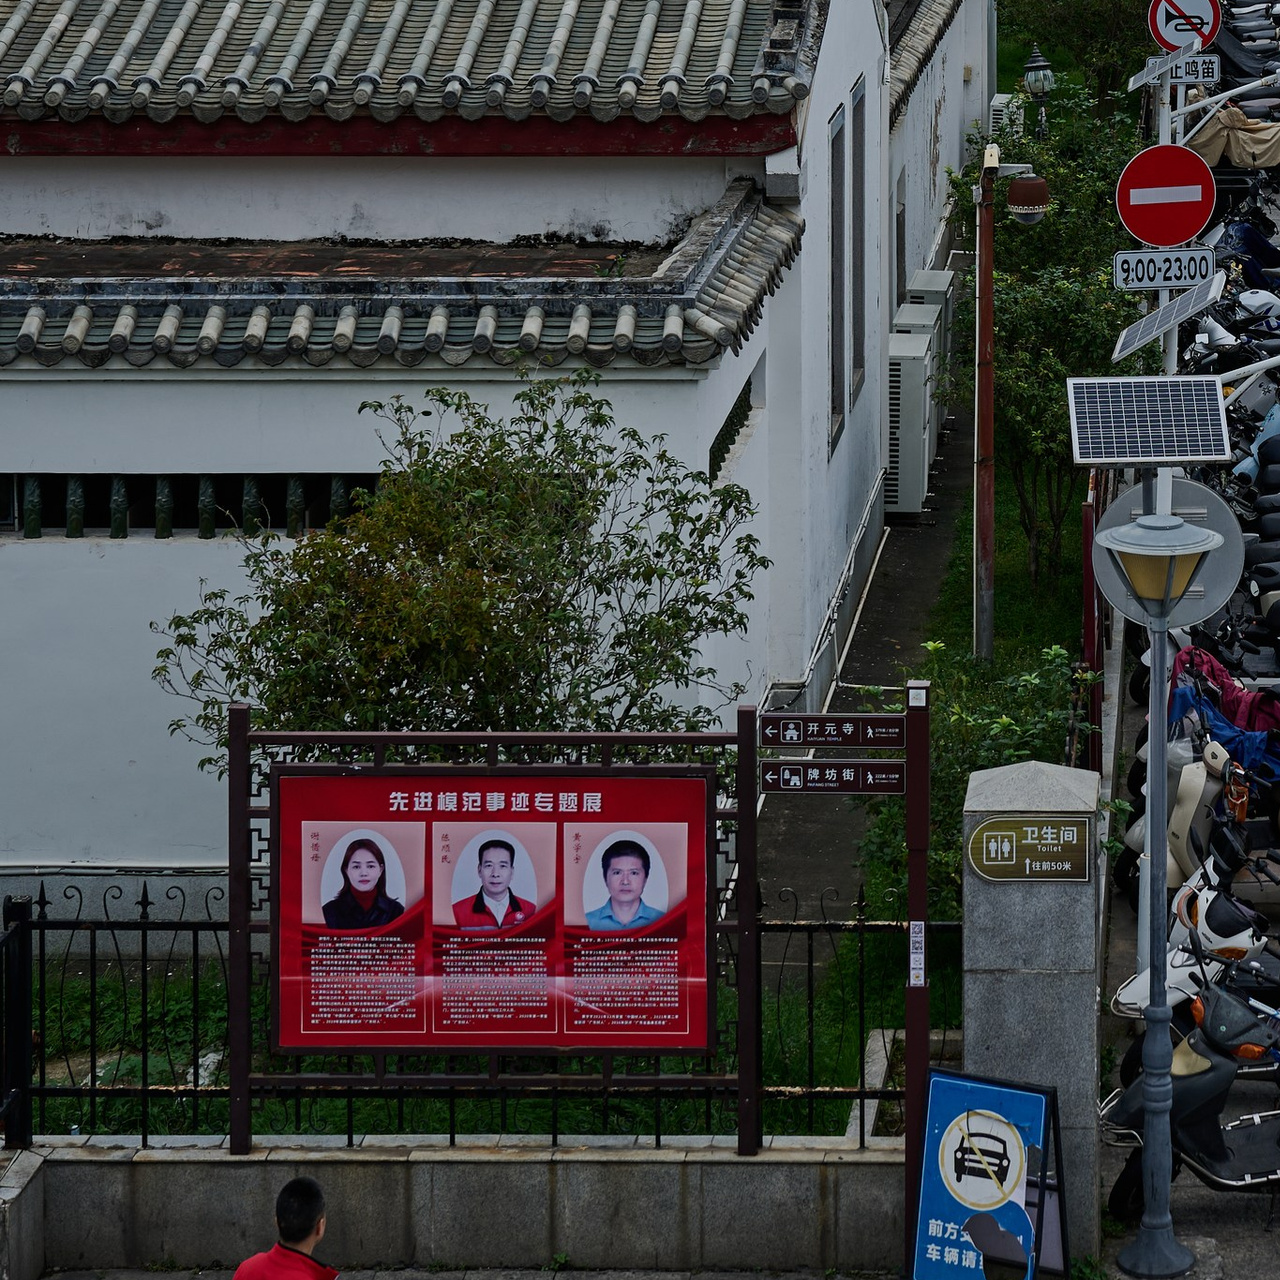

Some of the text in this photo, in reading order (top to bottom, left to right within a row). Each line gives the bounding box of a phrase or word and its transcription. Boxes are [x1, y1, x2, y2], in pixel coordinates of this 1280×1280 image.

[1121, 255, 1209, 284] 9:00-23:00
[807, 723, 854, 735] 开元寺
[807, 768, 855, 781] 牌坊街
[389, 792, 602, 812] 先进模范事迹专题展
[1022, 826, 1077, 844] 卫生间
[1032, 861, 1072, 872] 往前50米
